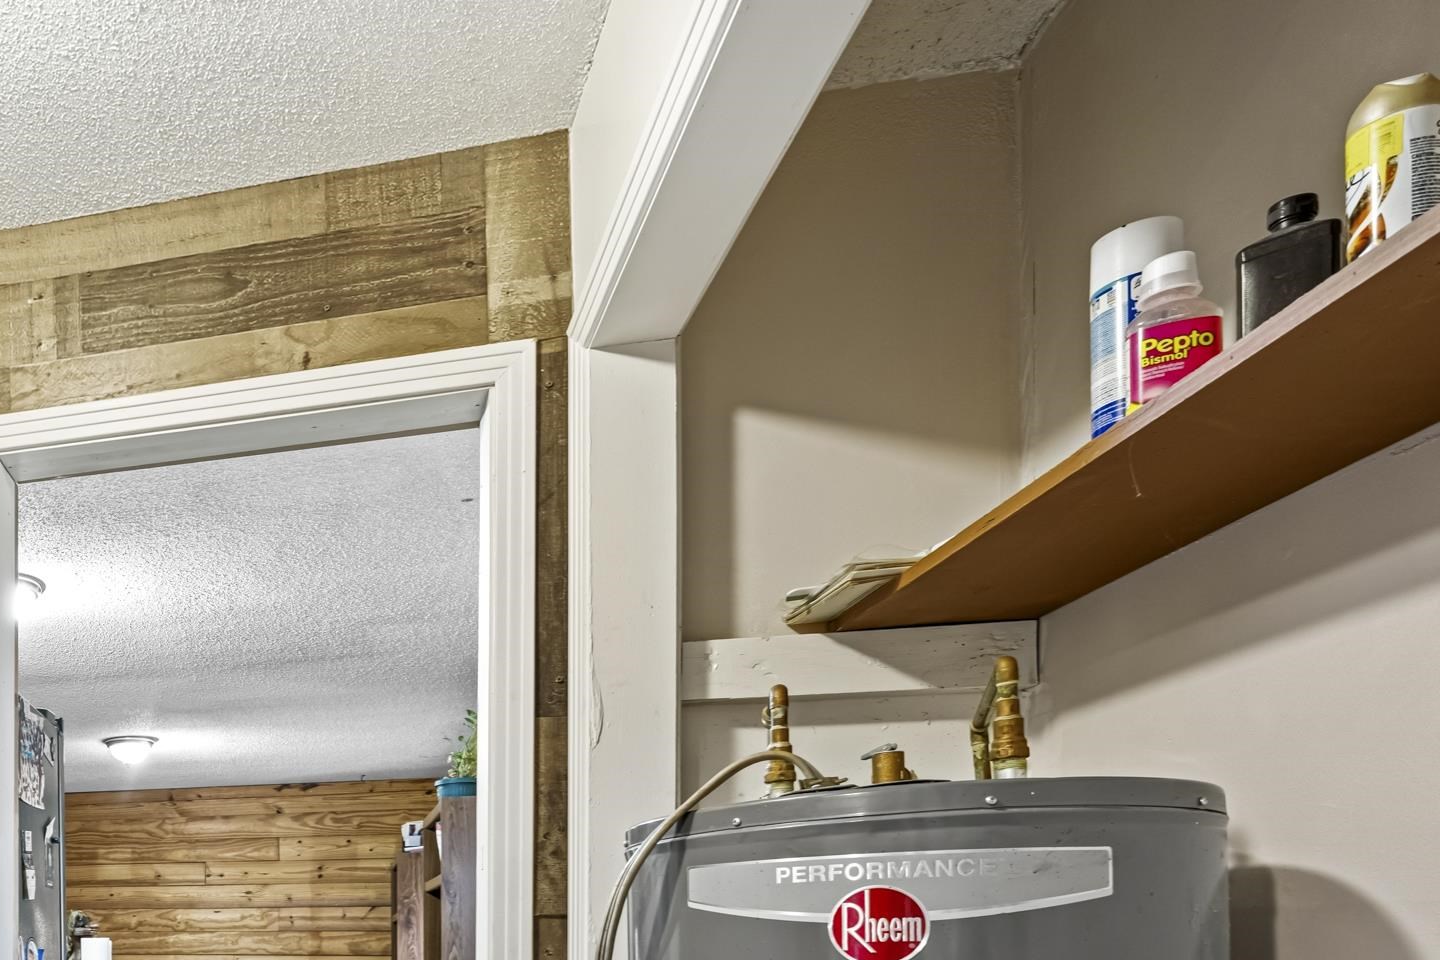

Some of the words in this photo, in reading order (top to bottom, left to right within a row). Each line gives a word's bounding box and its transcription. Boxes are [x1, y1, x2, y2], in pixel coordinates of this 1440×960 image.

[1141, 330, 1214, 357] Pepto
[1142, 349, 1188, 367] Bismol
[775, 858, 997, 884] PERFORMANCE
[842, 889, 922, 953] Rheem
